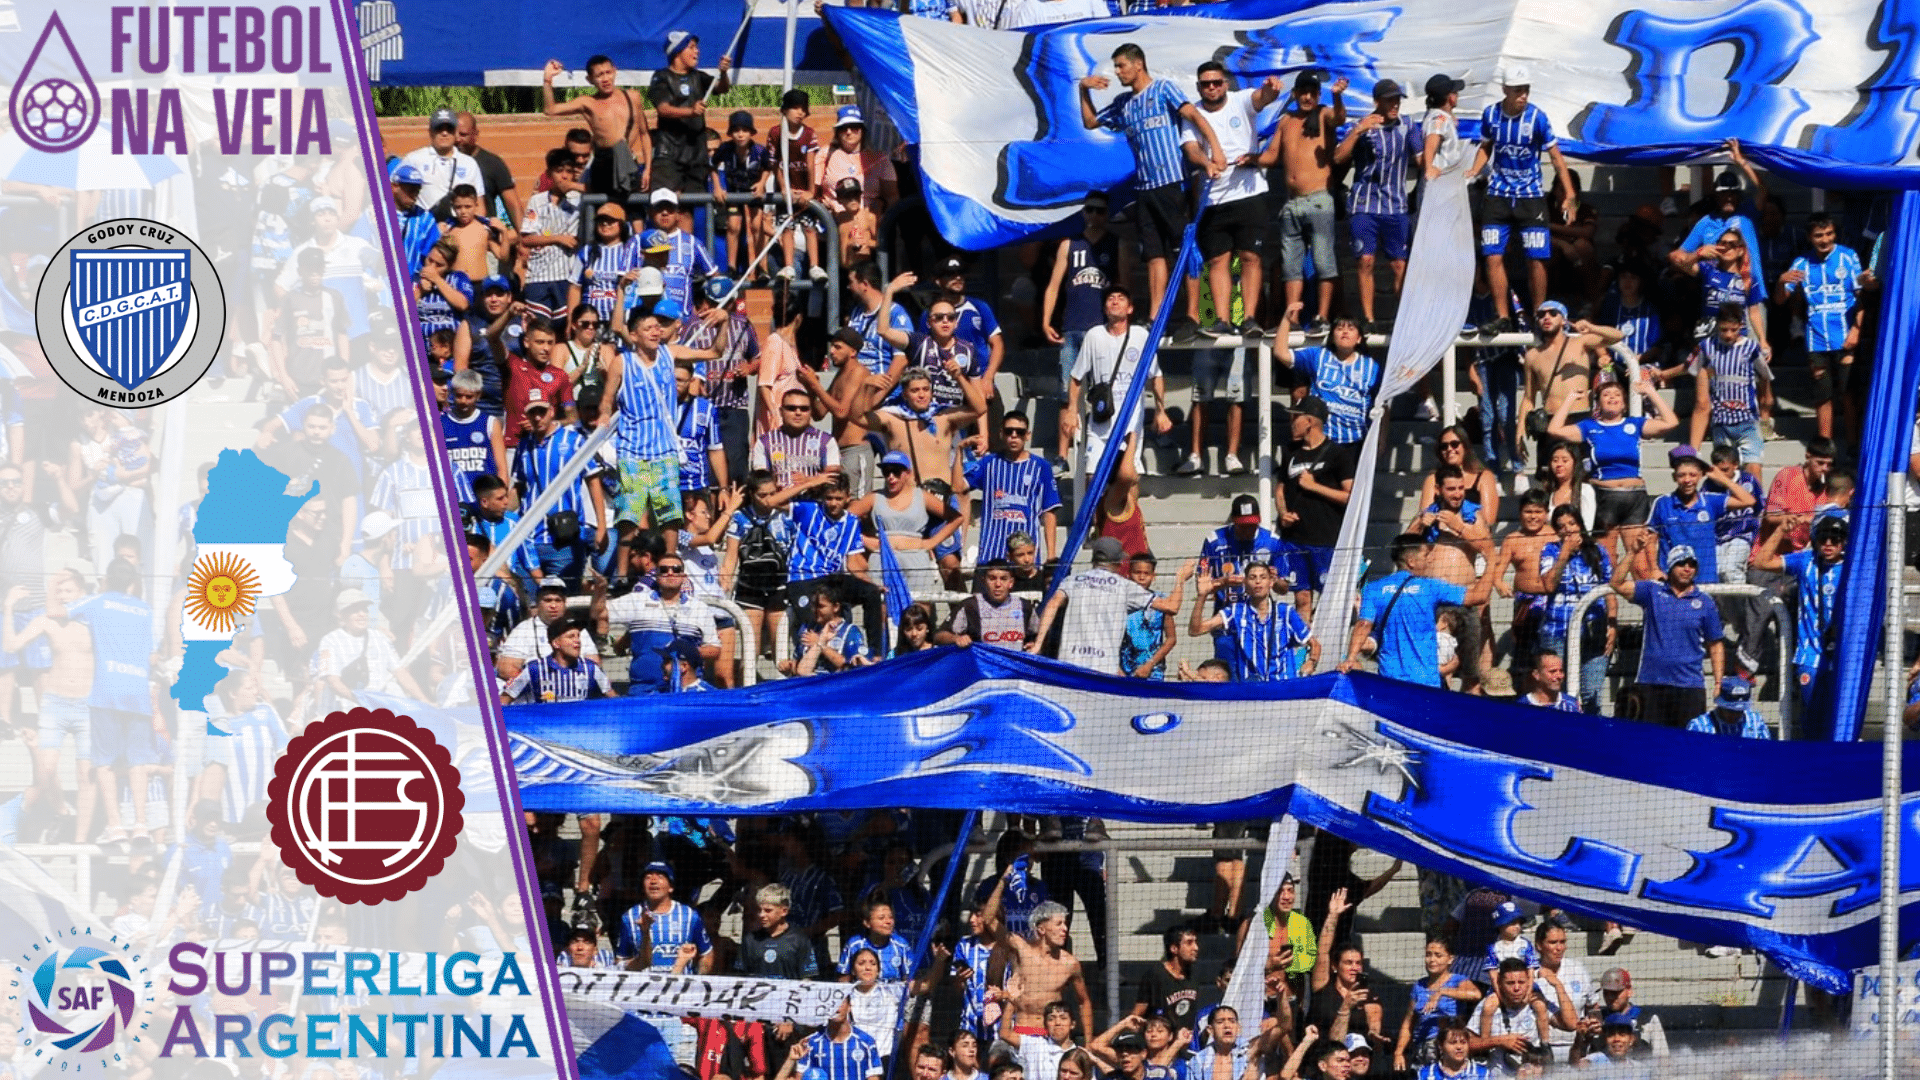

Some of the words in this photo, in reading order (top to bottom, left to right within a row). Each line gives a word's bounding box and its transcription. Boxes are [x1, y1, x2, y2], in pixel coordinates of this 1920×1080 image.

[1073, 250, 1087, 268] 11
[1317, 380, 1362, 402] CATA
[455, 460, 486, 473] RUZ
